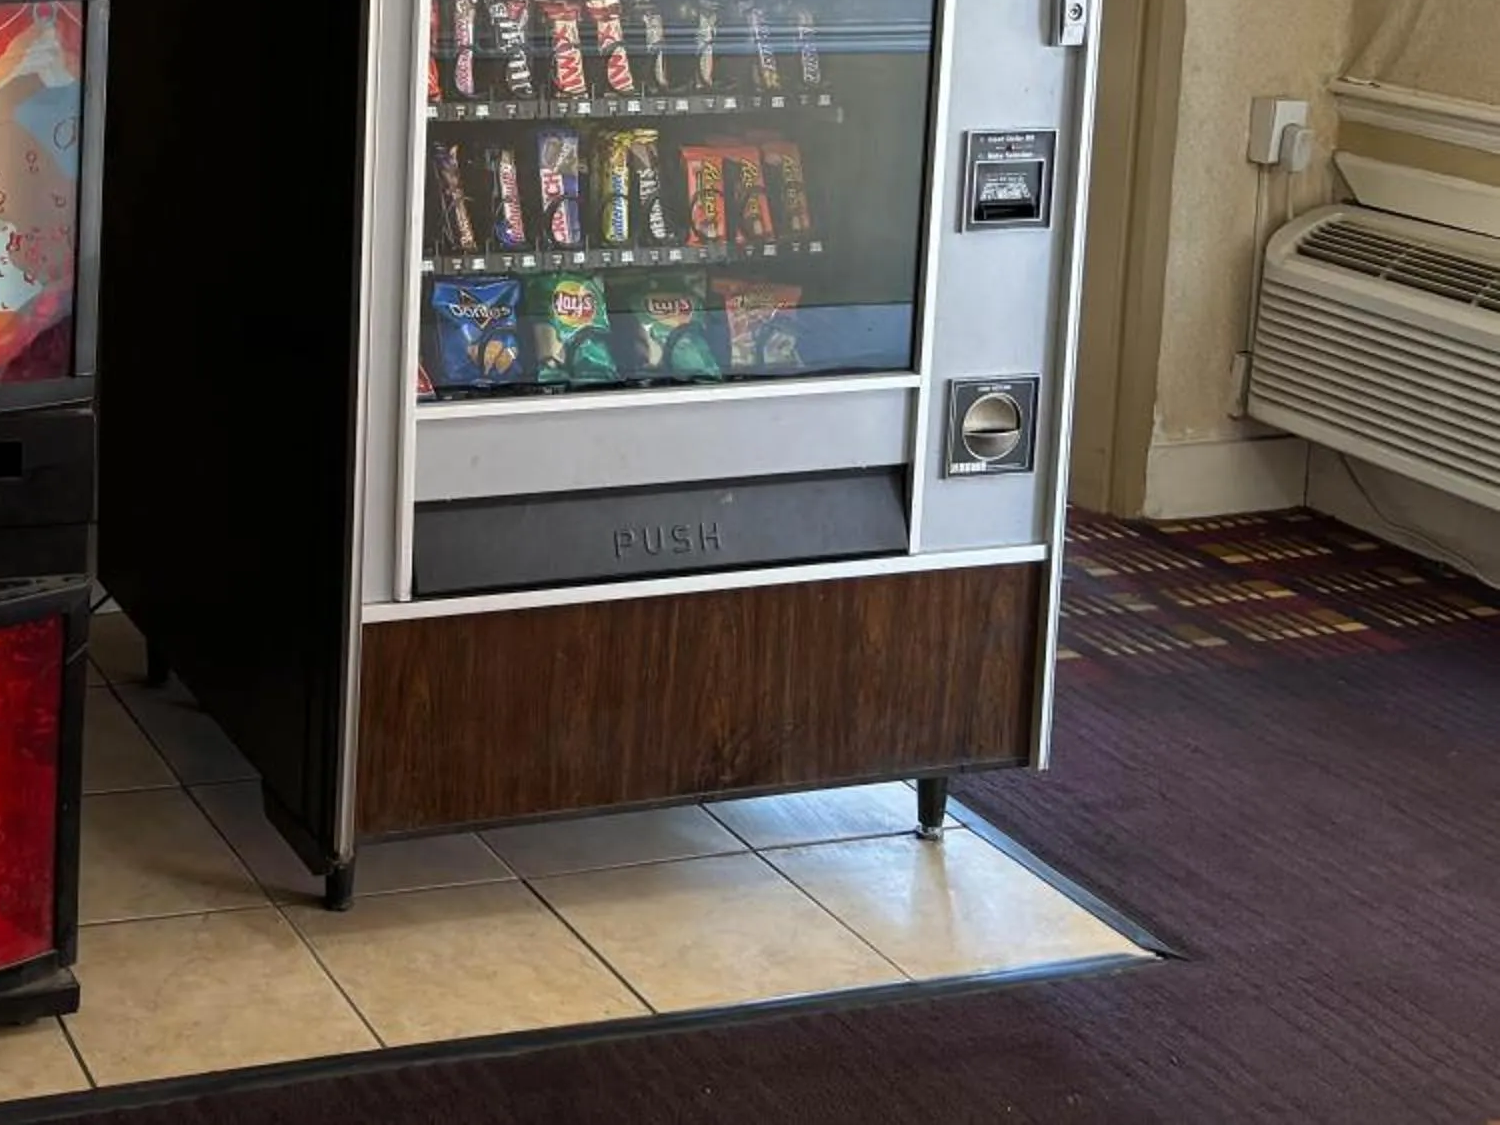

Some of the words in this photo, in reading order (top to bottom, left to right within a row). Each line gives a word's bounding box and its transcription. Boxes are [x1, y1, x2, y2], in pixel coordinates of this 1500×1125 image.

[552, 26, 582, 89] TWX
[598, 24, 631, 88] TWX
[556, 293, 593, 316] Lay's
[613, 521, 723, 560] PUSH
